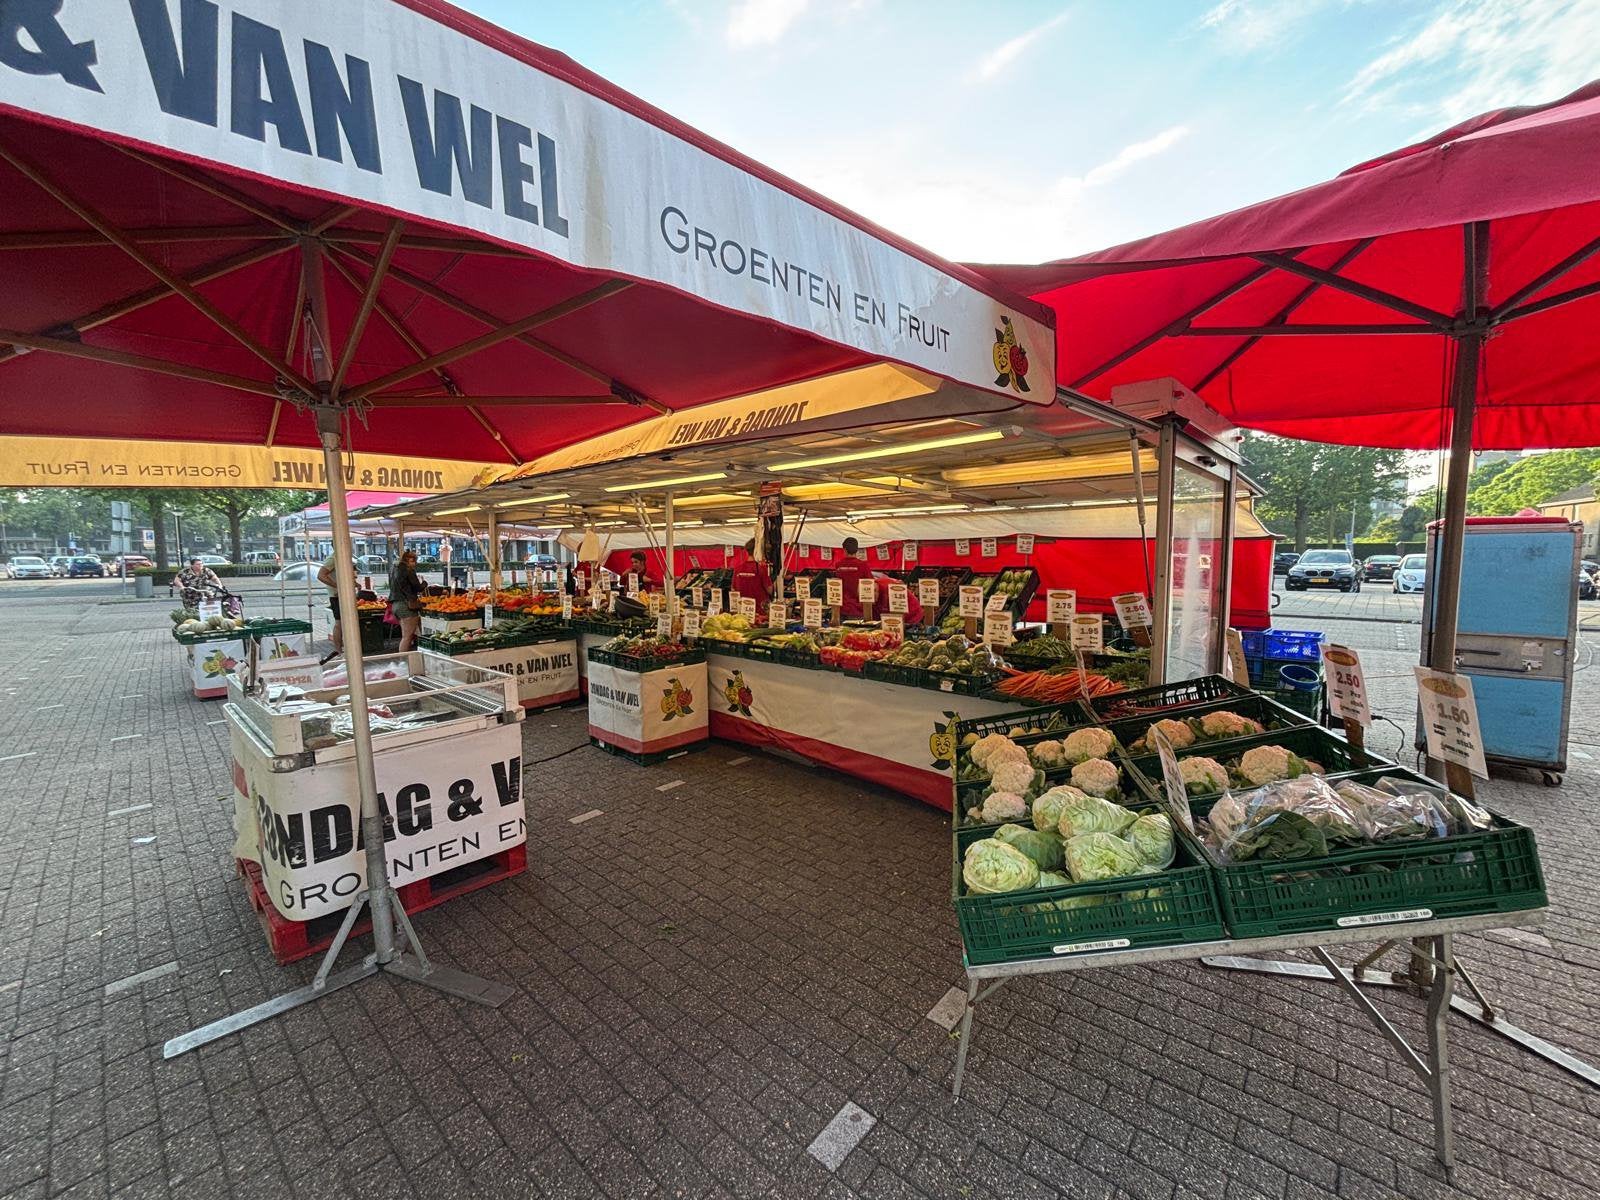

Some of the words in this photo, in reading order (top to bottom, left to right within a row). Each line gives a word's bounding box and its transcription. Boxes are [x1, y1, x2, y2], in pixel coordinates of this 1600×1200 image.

[129, 0, 383, 175] VAN
[397, 74, 569, 239] WEL
[660, 206, 841, 313] GROENTEN
[854, 292, 886, 328] EN
[898, 302, 950, 353] FRUIT
[1124, 604, 1145, 613] 2.50
[1079, 627, 1099, 635] 1.95
[516, 662, 525, 676] &
[525, 657, 549, 674] VAN
[550, 653, 573, 670] WEL
[1336, 670, 1360, 688] 2.50
[627, 692, 640, 707] WEL
[1437, 702, 1470, 725] 1.50
[447, 778, 483, 822] &
[280, 831, 481, 909] GRONTEN
